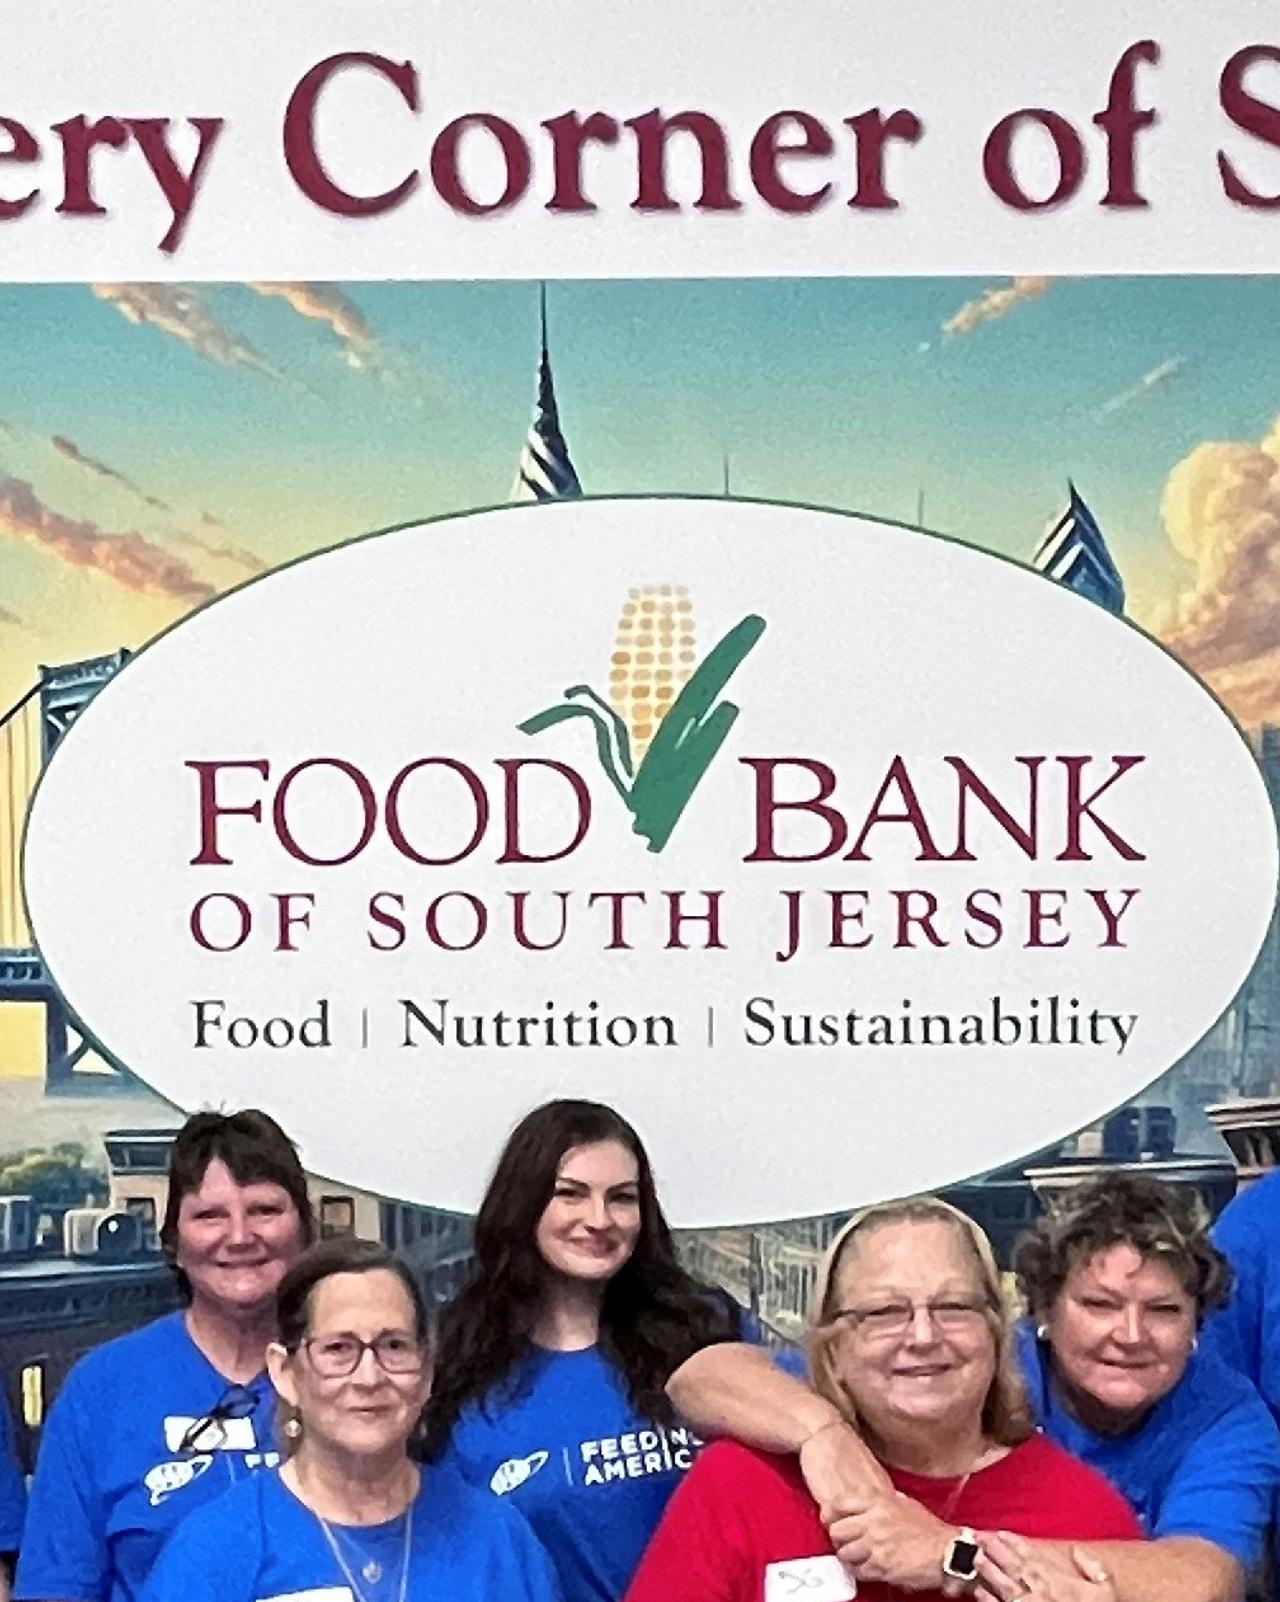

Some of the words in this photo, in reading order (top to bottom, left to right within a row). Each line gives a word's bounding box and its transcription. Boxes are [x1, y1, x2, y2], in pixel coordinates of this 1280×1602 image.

[283, 52, 924, 219] Corner
[982, 40, 1161, 214] of
[184, 757, 592, 866] FOOD
[738, 755, 1147, 863] BANK
[190, 893, 315, 952] OF
[367, 890, 728, 951] SOUTH
[776, 889, 1140, 962] JERSEY
[191, 999, 332, 1048] Food
[398, 999, 678, 1048] Nutrition
[746, 995, 1138, 1055] Sustainability
[584, 1448, 693, 1487] AMERIC
